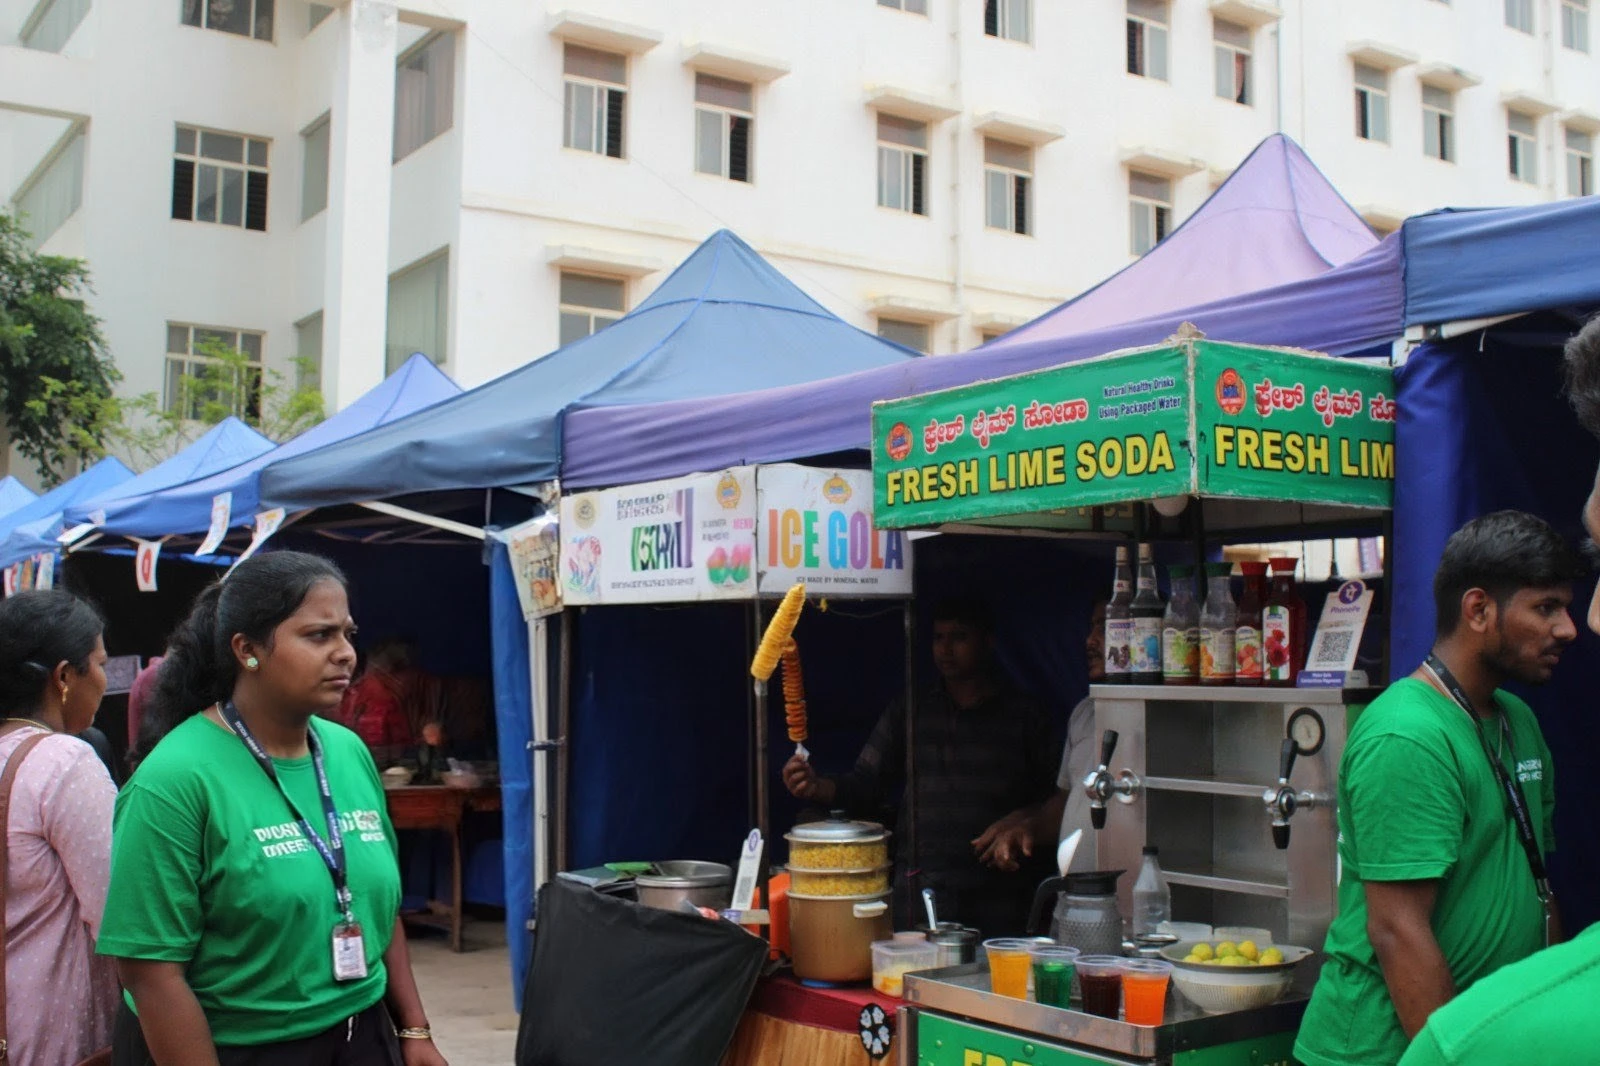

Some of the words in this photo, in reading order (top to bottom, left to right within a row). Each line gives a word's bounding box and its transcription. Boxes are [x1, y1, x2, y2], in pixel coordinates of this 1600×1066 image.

[1103, 384, 1126, 398] Natural
[1128, 380, 1153, 394] Healthy
[1153, 376, 1175, 390] Drinks
[1099, 405, 1120, 419] Using
[1120, 399, 1157, 416] Packaged
[1158, 396, 1181, 410] Water
[886, 458, 980, 506] FRESH
[989, 446, 1066, 492] LIME
[1076, 431, 1175, 482] SODA
[1215, 425, 1330, 474] FRESH
[1340, 438, 1395, 479] LIM
[769, 509, 819, 568] ICE
[828, 510, 903, 570] GOLA
[807, 576, 823, 584] MADE
